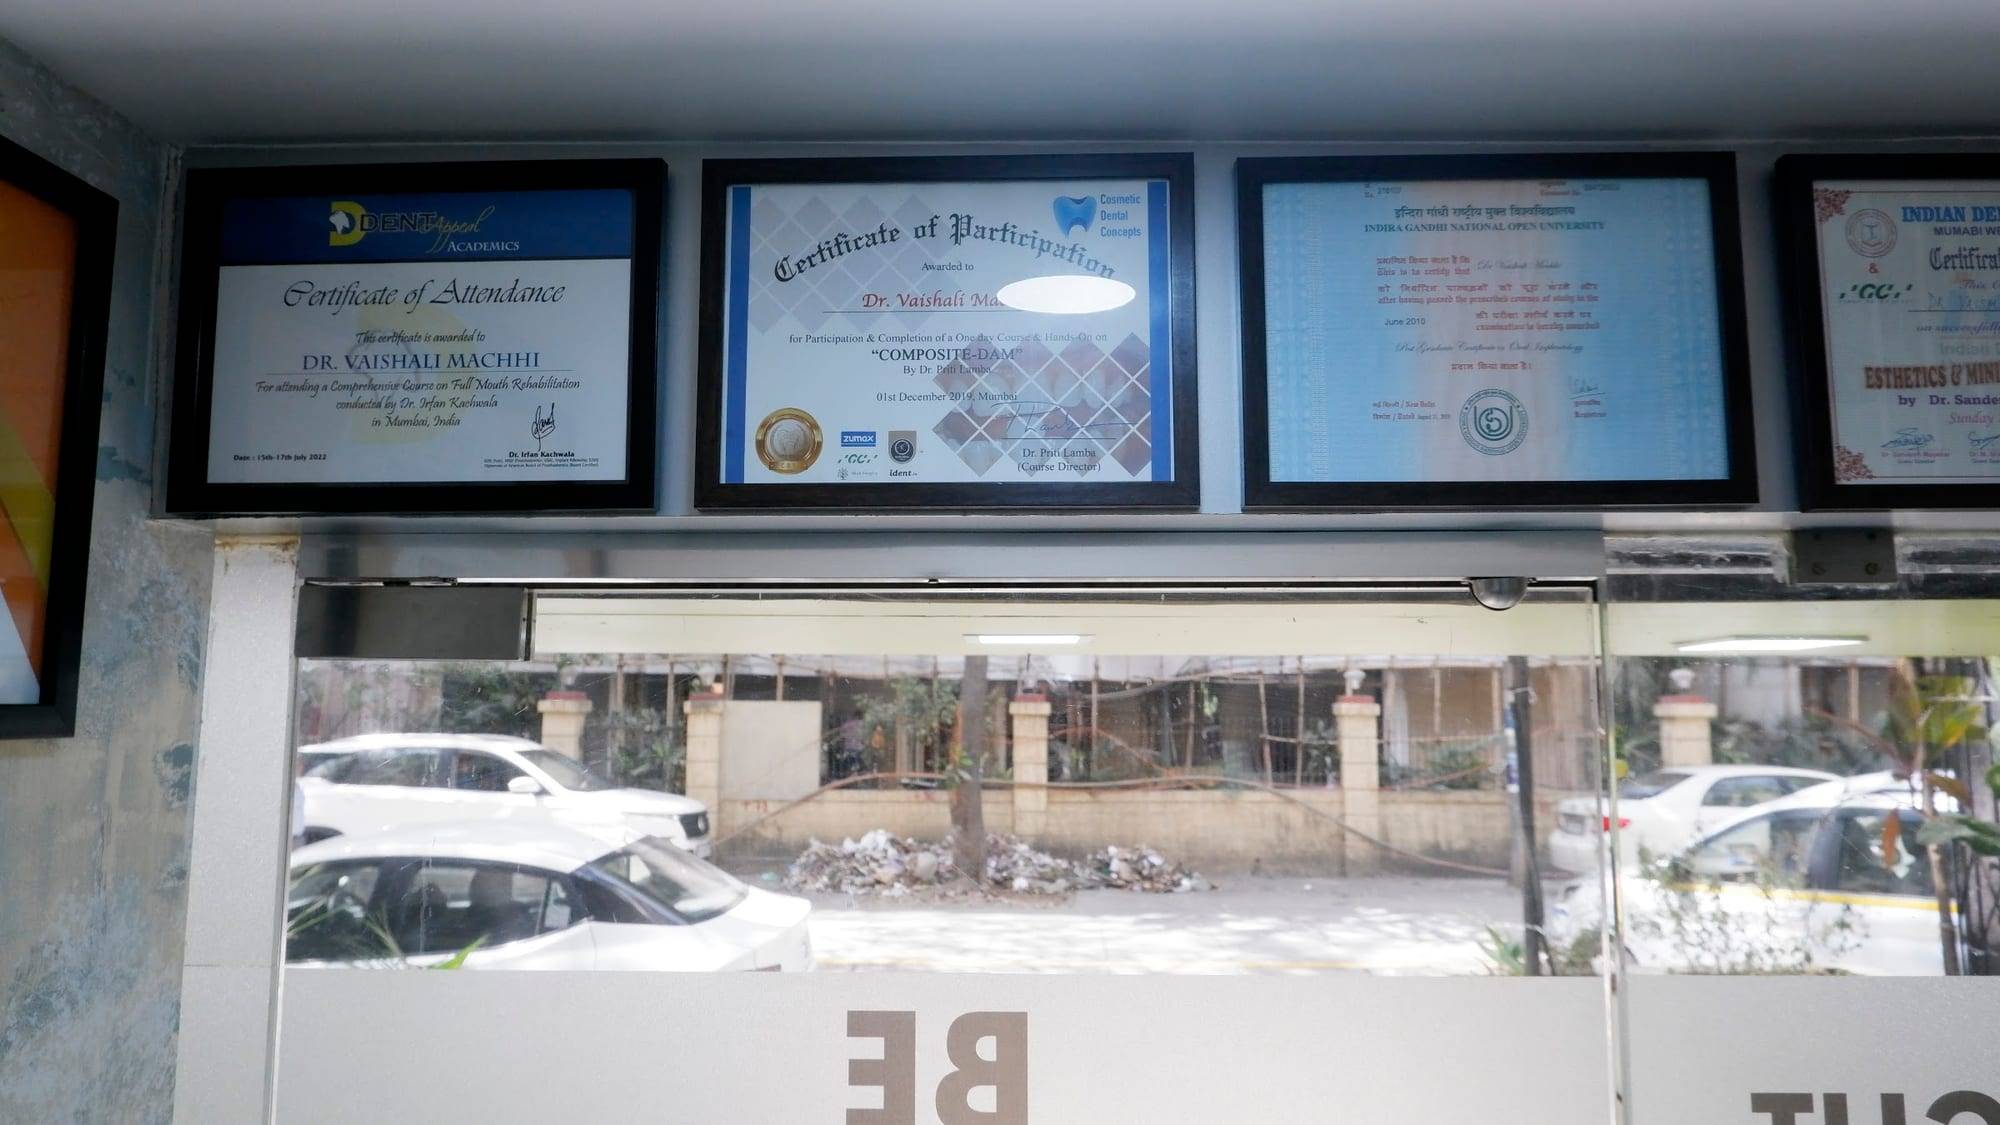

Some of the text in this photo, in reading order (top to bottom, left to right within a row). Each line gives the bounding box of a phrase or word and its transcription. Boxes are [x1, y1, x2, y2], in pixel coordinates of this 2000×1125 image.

[1100, 194, 1141, 205] Cosmetic
[1100, 211, 1129, 221] Dental
[1901, 205, 2000, 223] INDIAN DE
[360, 211, 437, 233] DENT
[1364, 221, 1605, 233] INDIRA GANDHI NATIONAL OPEN UNIVERSITY
[1100, 227, 1142, 239] Concepts
[1934, 226, 1983, 236] MUMABI
[448, 240, 520, 252] ACADEMICS
[774, 212, 1116, 283] Certificate of Participation
[921, 262, 975, 272] Awarded to
[283, 278, 567, 316] Certificate of Attendance
[862, 293, 890, 308] Dr.
[896, 289, 965, 308] Vaishali
[1384, 318, 1404, 327] June
[355, 328, 486, 346] This certificate is awarded to
[789, 333, 802, 343] for
[806, 333, 864, 345] Participation
[866, 335, 875, 343] &
[878, 333, 933, 344] Completion
[935, 333, 946, 342] of
[956, 333, 976, 342] One
[979, 333, 993, 344] day
[997, 333, 1032, 342] Course
[1045, 332, 1092, 342] Hands-On
[303, 352, 541, 370] DR. VAISHALI MACHHI
[903, 364, 991, 376] By Dr. Priti Lamba
[1864, 365, 1947, 389] ESTHETICS
[255, 375, 581, 398] For attending a Comprehensive Course on Full Mouth Rehabilitation
[876, 391, 1017, 402] 01st December 2019, Mumbai
[1898, 394, 2000, 408] by Dr. Sande
[336, 394, 498, 414] conducted by Dr. Irfan Kachwala
[371, 412, 461, 428] in Mumbai, India
[843, 435, 874, 443] zumax
[309, 453, 327, 461] 2022
[1022, 448, 1096, 458] Dr. Priti Lamba
[1017, 462, 1101, 472] (Course Director)
